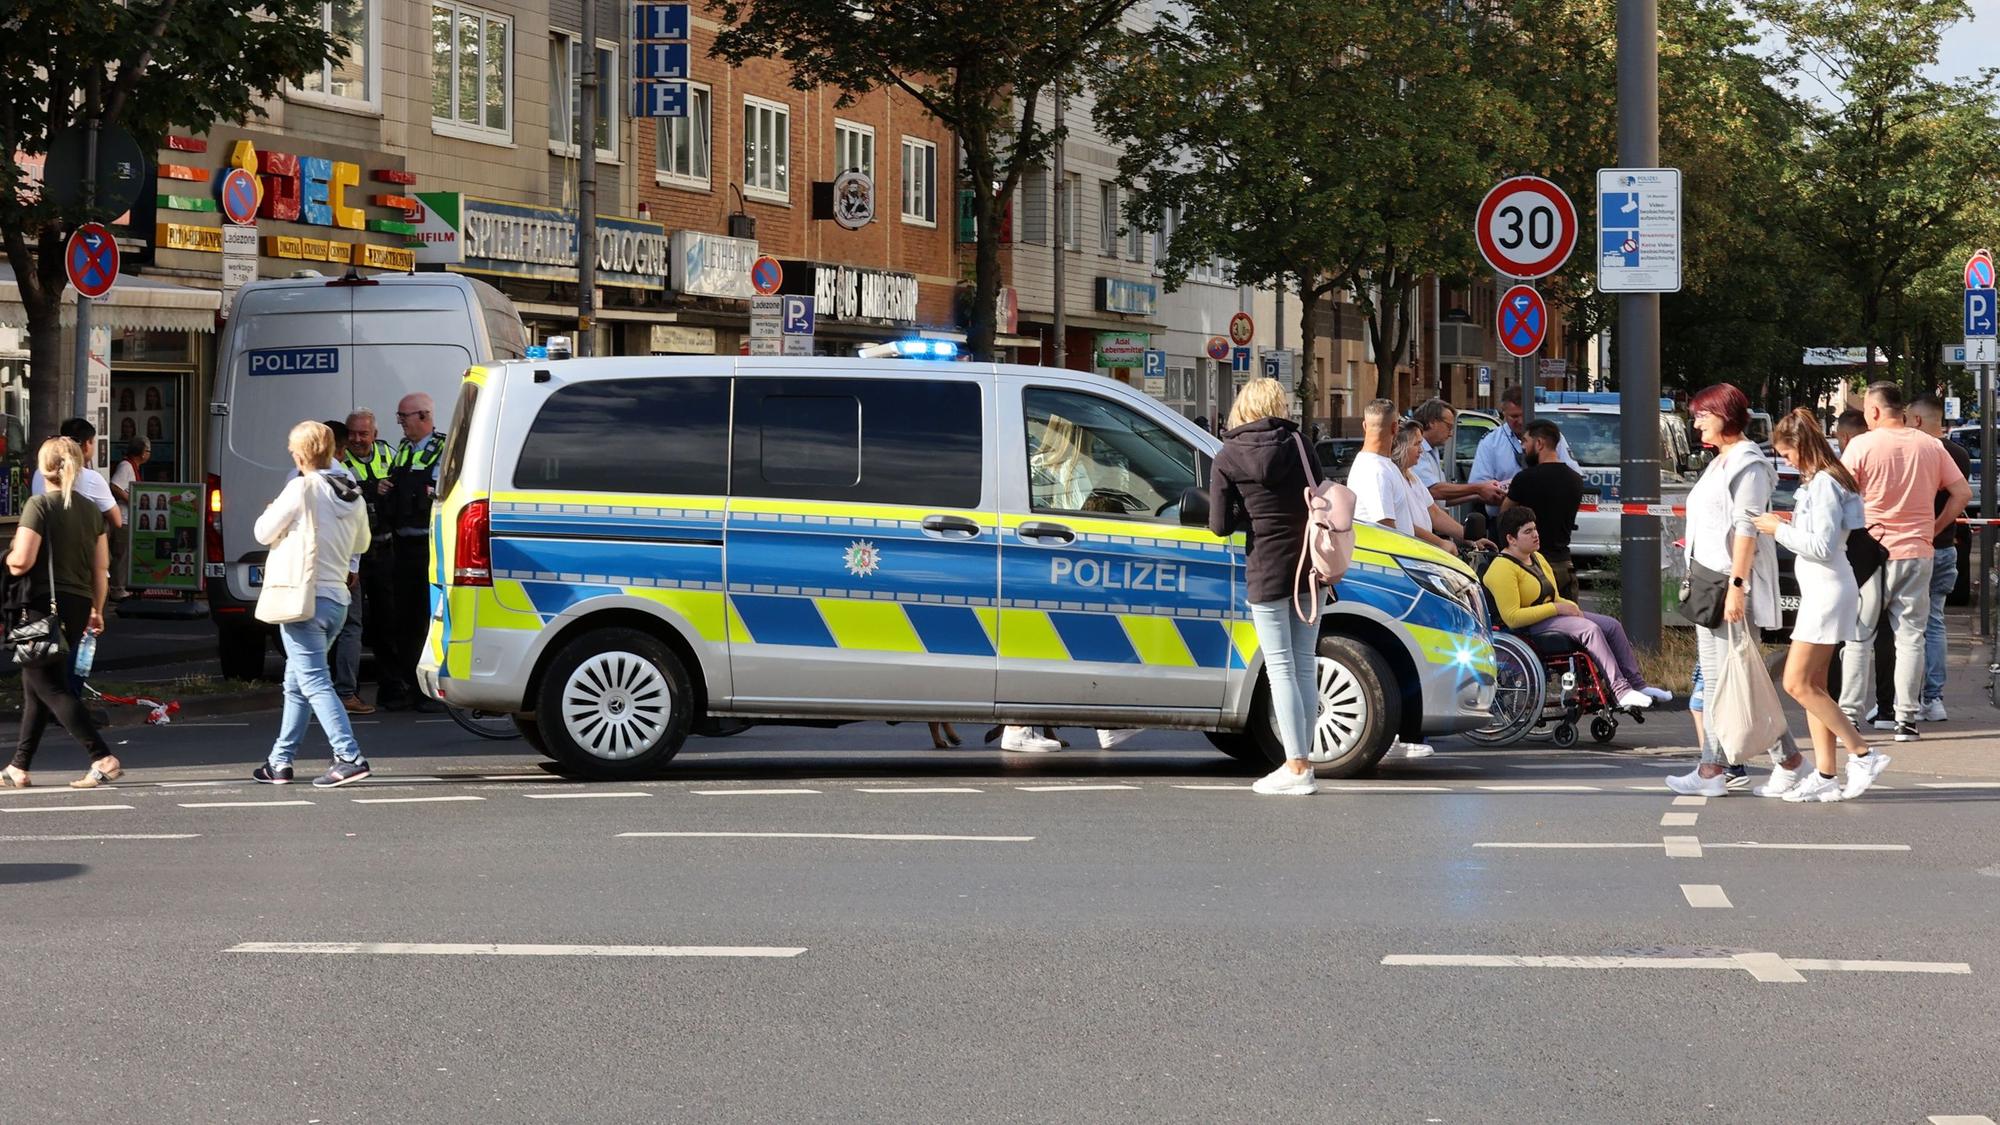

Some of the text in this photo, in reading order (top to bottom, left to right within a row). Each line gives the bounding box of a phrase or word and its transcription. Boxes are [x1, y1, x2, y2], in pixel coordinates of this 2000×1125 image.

[224, 232, 256, 244] Ladezone
[1498, 206, 1554, 250] 30
[228, 264, 254, 274] werktags
[752, 301, 780, 309] Ladezone
[861, 273, 919, 322] BARBERSHOP
[788, 300, 806, 329] P
[1970, 294, 1987, 330] P
[1101, 346, 1144, 354] Lebensmittel
[252, 351, 336, 371] POLIZEI
[1147, 354, 1159, 374] P
[1583, 473, 1621, 486] POLIZ
[1051, 556, 1187, 593] POLIZEI
